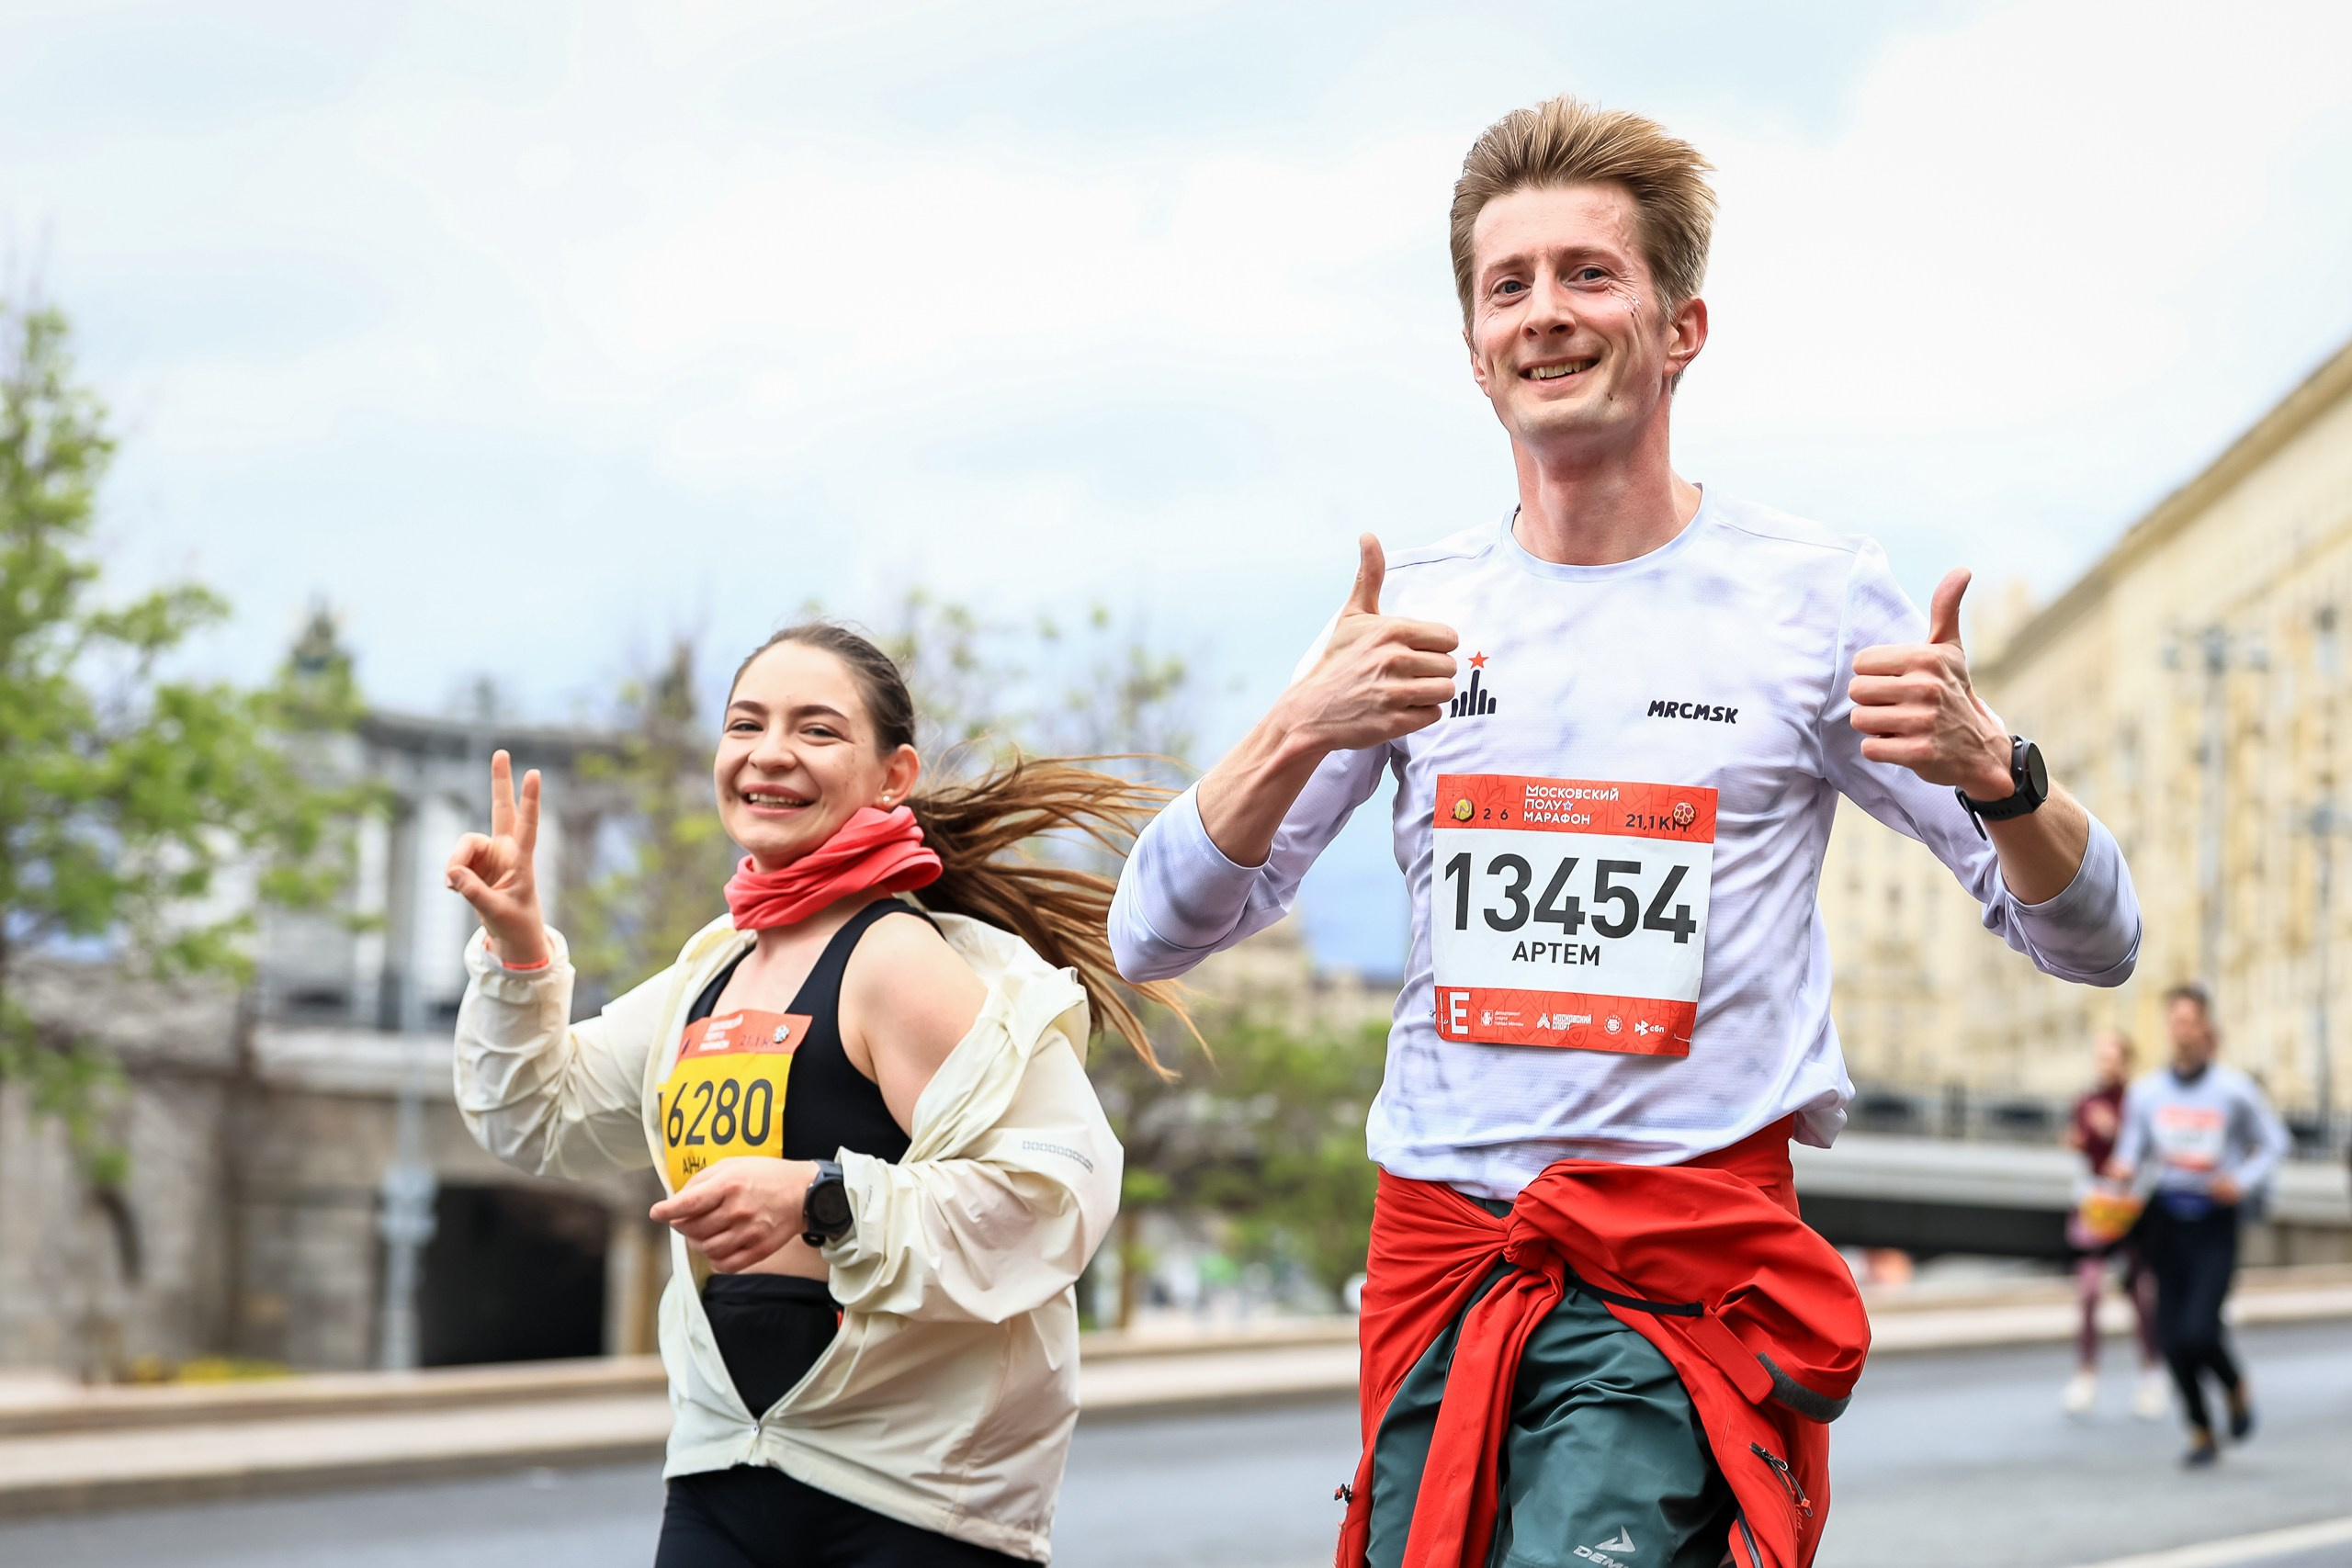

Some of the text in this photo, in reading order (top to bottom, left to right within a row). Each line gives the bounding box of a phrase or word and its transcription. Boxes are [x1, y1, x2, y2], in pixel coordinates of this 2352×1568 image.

[1647, 700, 1738, 725] MRCMSK
[1524, 798, 1563, 811] ПОЛУ
[1525, 784, 1620, 802] МОСКОВСКИЙ
[1523, 811, 1591, 825] МАРАФОН
[1444, 852, 1697, 944] 13454
[1511, 941, 1601, 966] АРТЕМ
[1573, 1545, 1630, 1568] DEM
